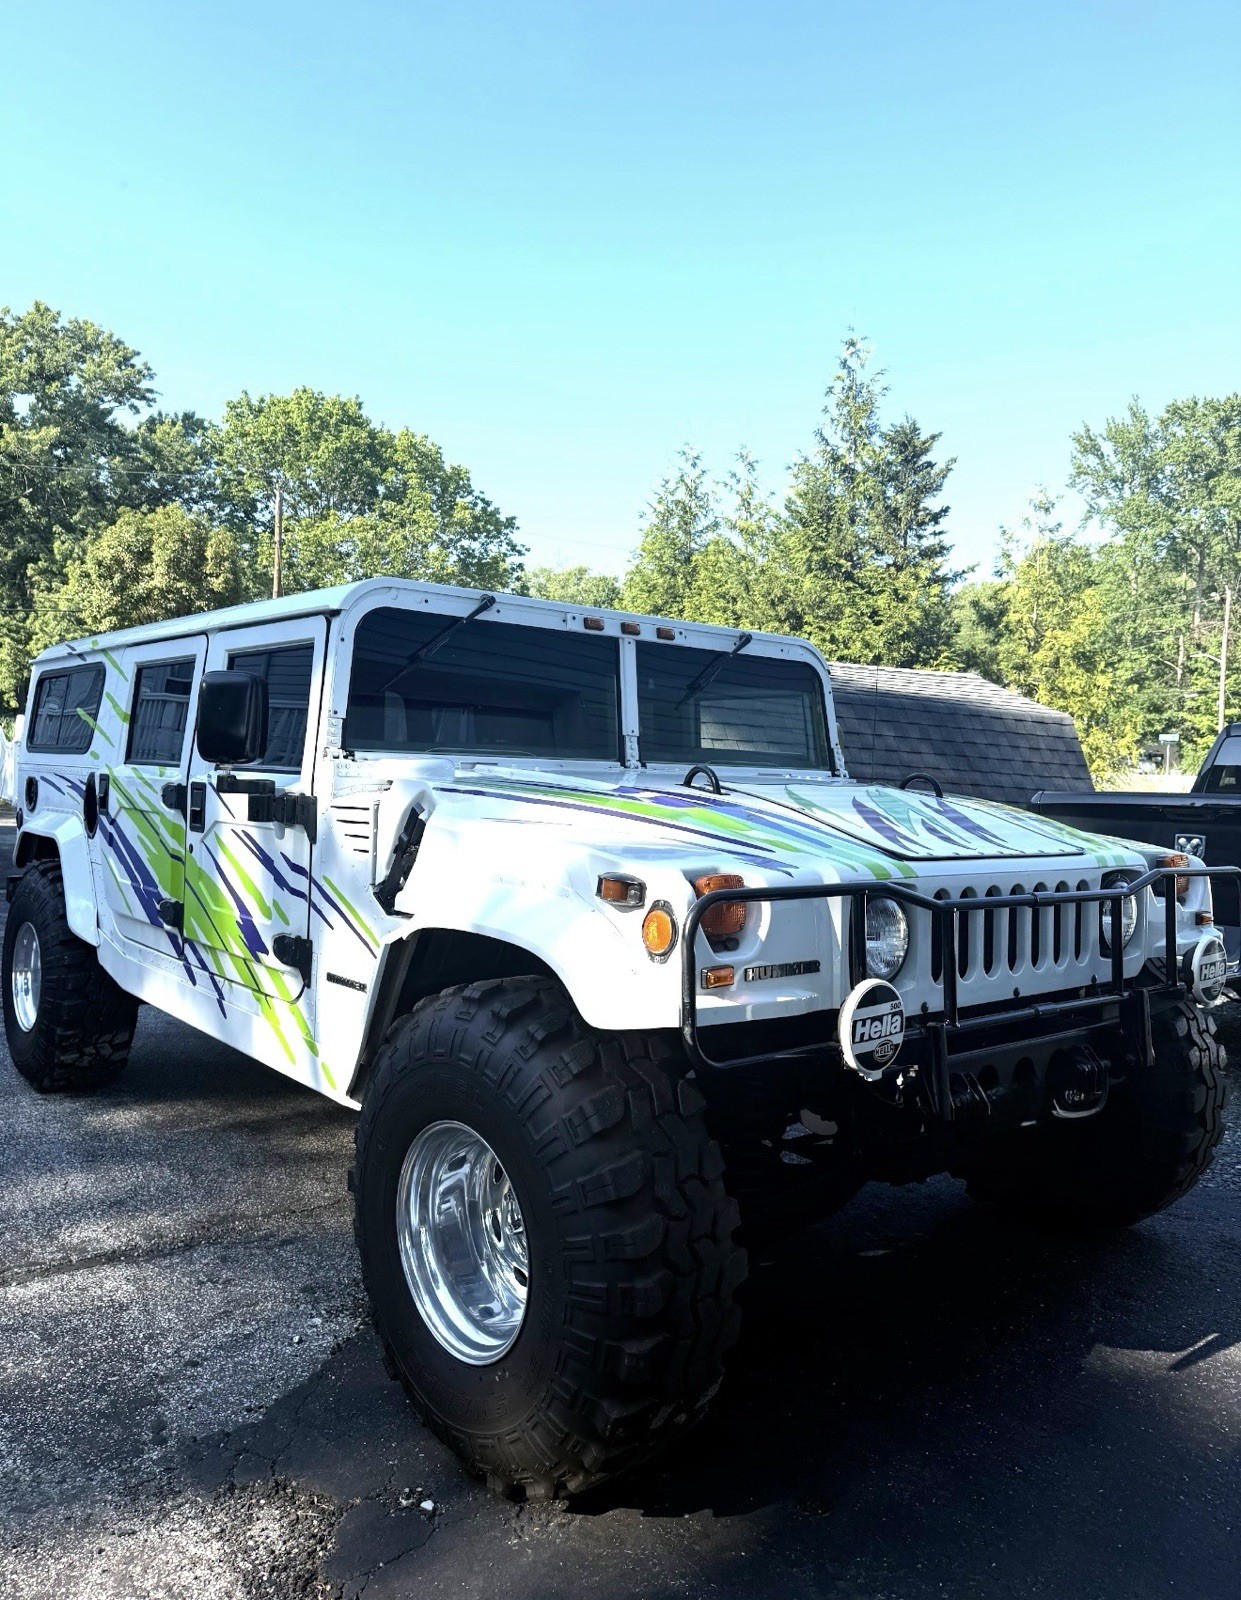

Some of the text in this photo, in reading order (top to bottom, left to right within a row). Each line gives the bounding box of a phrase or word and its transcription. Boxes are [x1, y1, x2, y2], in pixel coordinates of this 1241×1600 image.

[1201, 961, 1225, 980] Hella
[890, 1001, 902, 1010] 500
[855, 1014, 902, 1042] Hella
